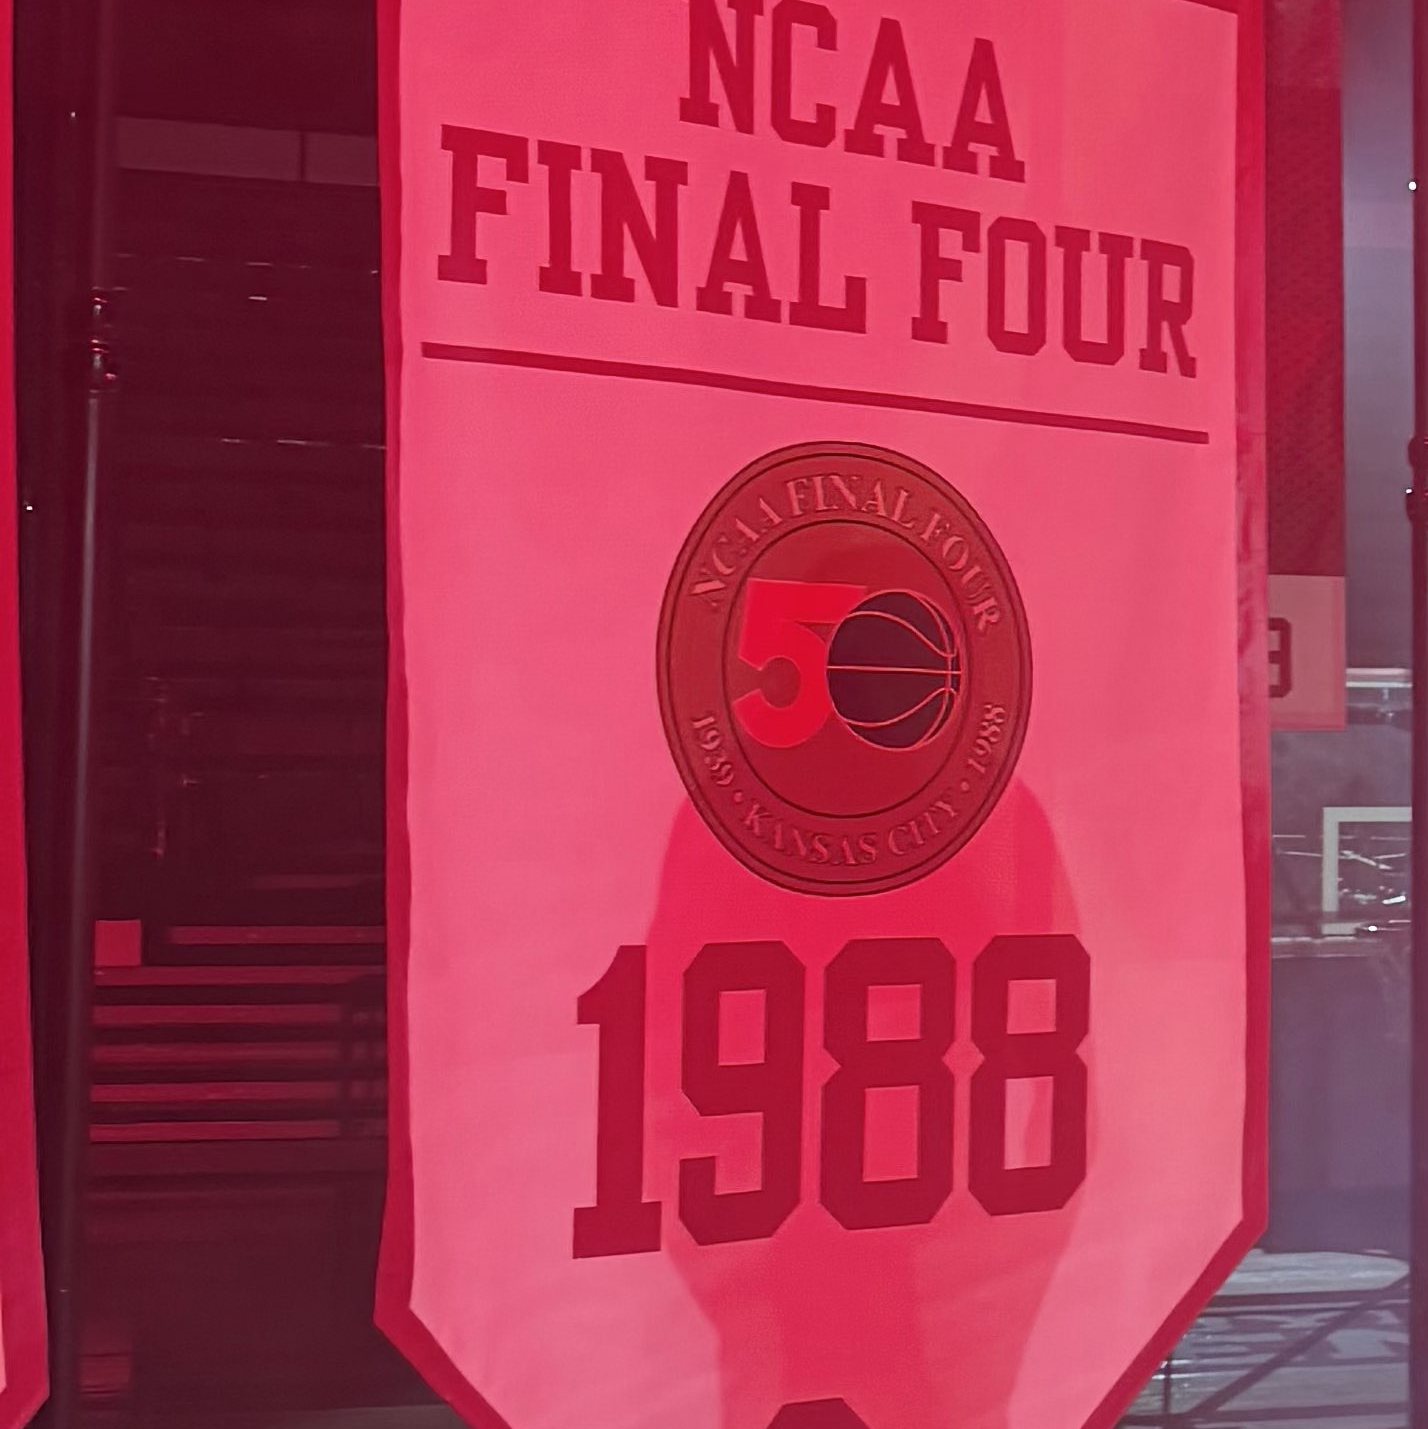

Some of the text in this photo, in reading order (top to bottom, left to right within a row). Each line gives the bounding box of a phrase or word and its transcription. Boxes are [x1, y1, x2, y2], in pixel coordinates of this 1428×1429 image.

[437, 124, 1197, 378] FINAL FOUR
[690, 474, 1001, 633] NCAA FINAL FOUR
[743, 802, 880, 866] KANSAS
[886, 797, 959, 856] CITY
[572, 934, 1091, 1259] 1988
